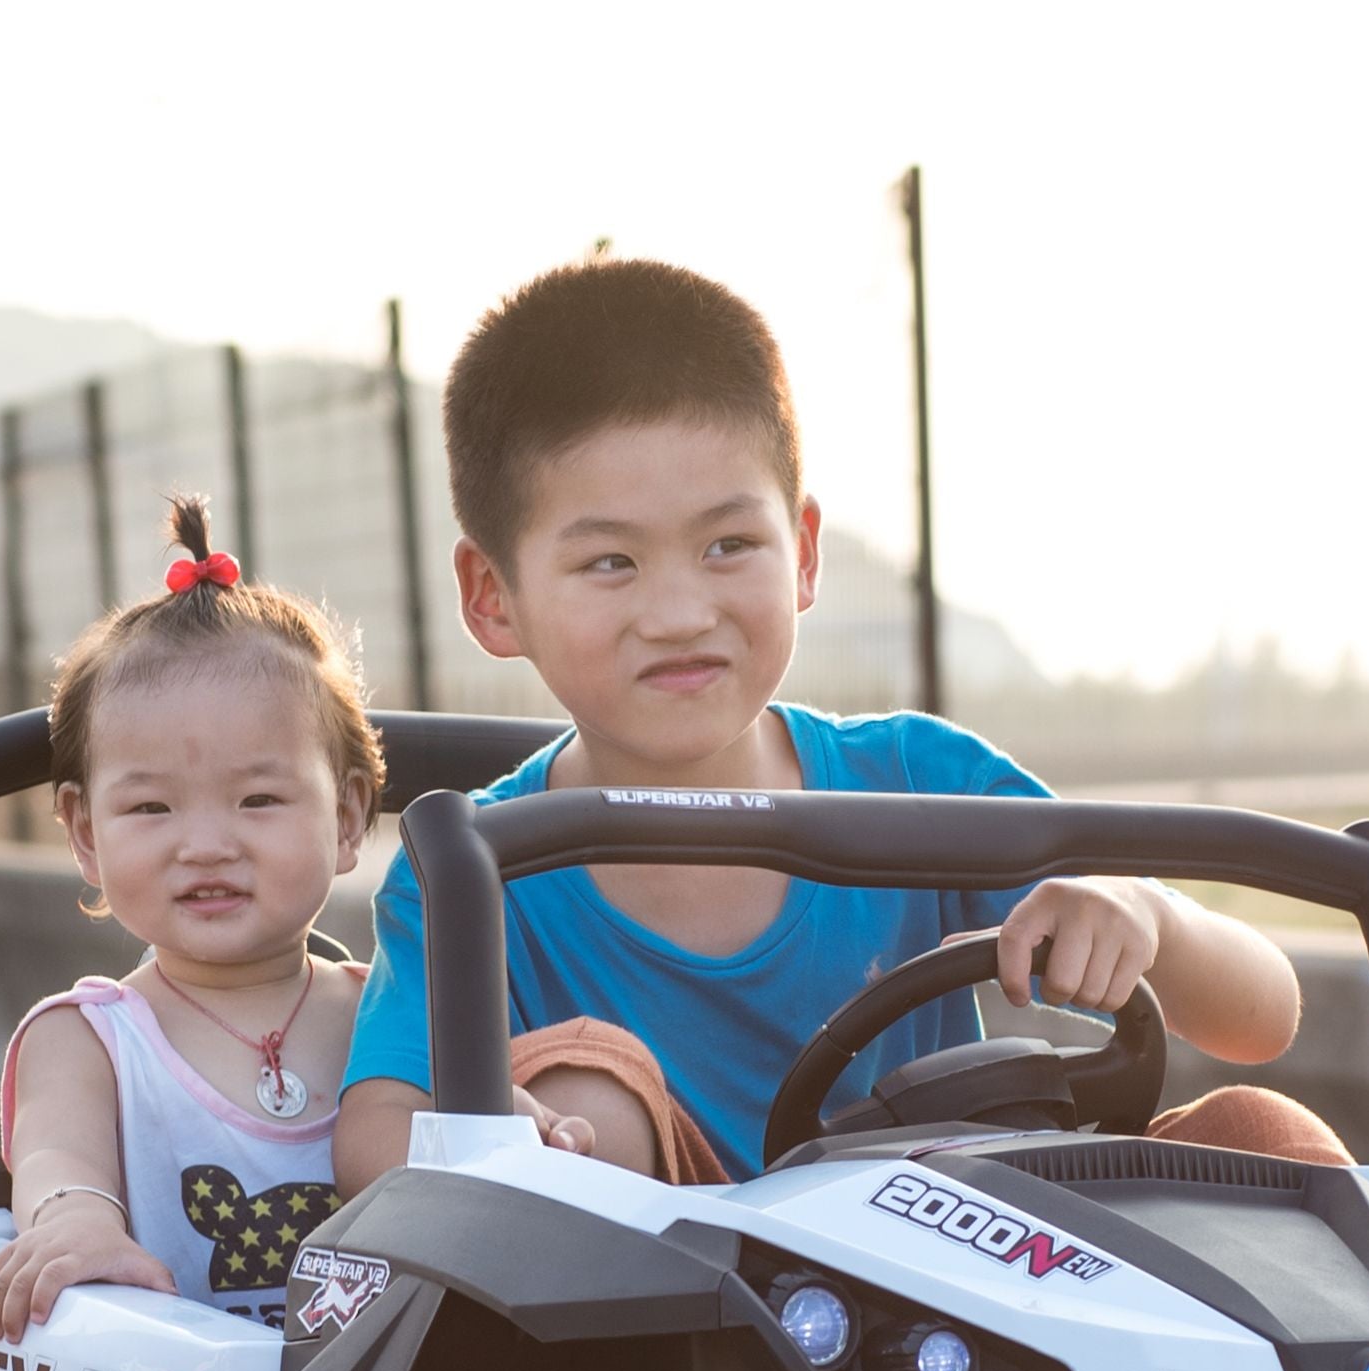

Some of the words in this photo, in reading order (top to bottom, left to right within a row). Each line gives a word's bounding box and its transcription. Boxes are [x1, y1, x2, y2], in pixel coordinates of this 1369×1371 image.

[607, 789, 733, 808] SUPERSTAR
[739, 793, 771, 808] V2
[367, 1267, 386, 1285] V2
